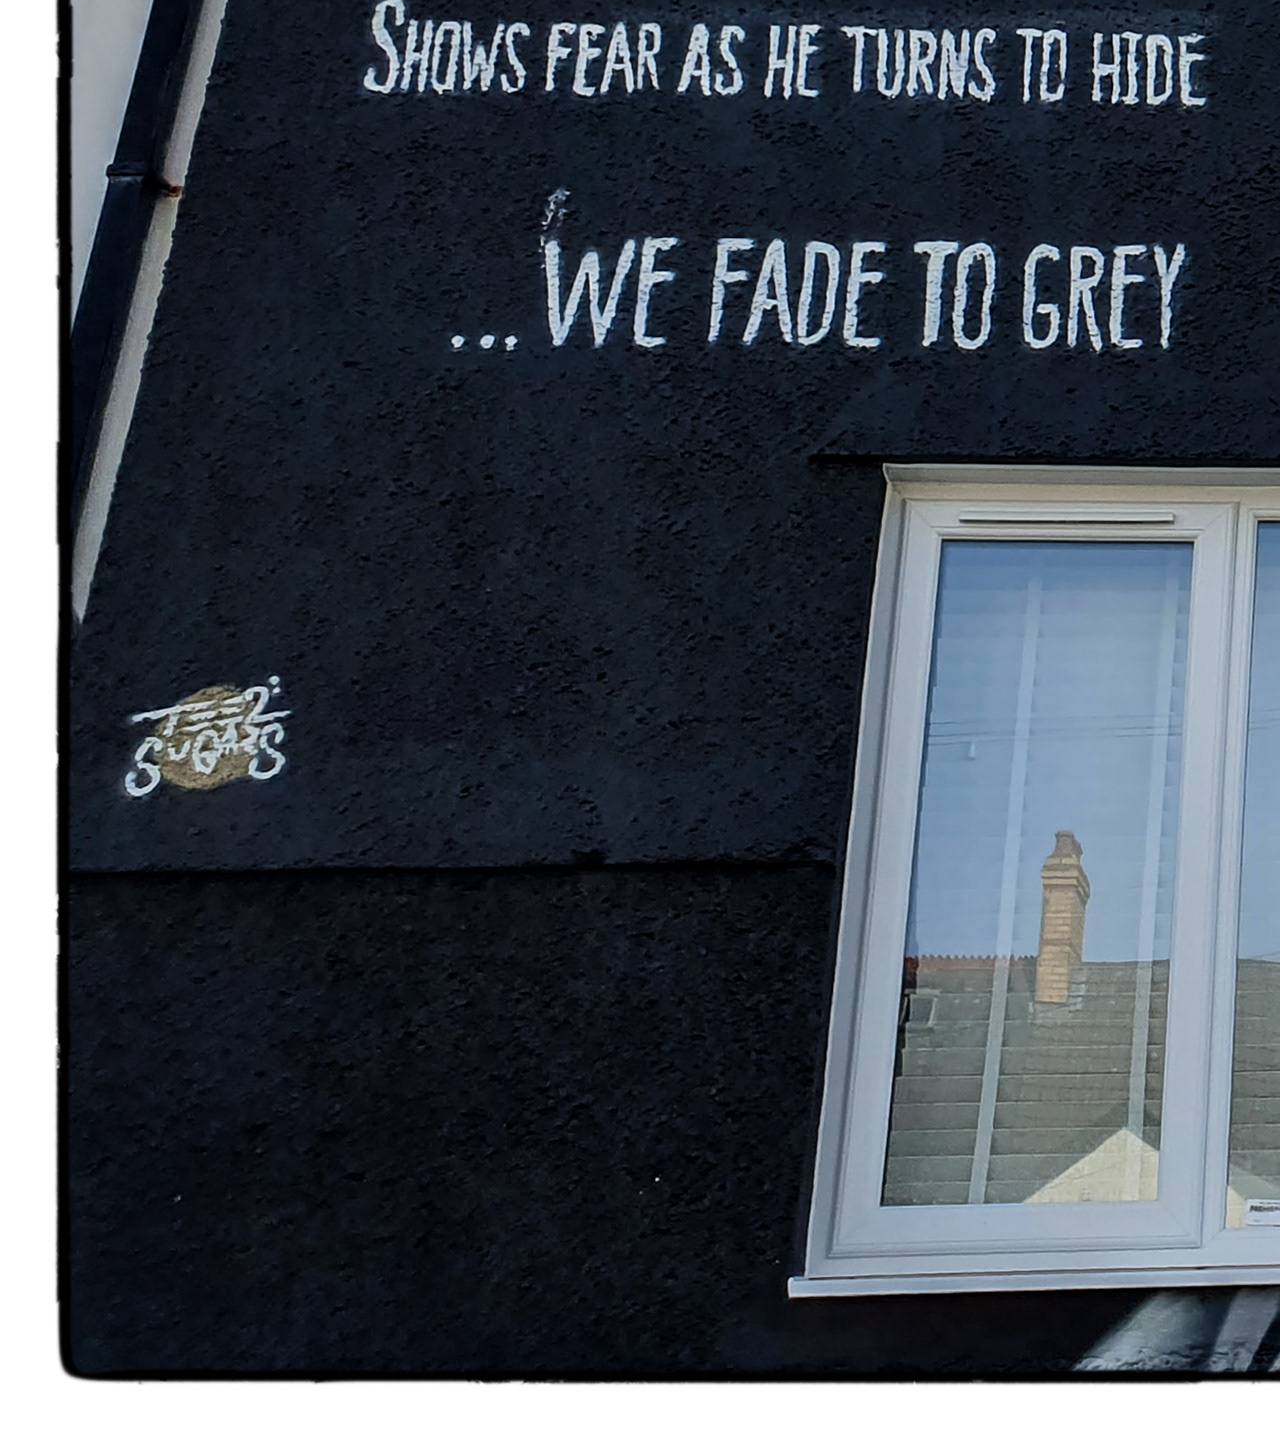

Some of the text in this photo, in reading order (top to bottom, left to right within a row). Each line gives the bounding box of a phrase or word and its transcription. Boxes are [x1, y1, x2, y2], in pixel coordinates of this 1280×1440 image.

[545, 22, 661, 96] FEAR
[677, 24, 745, 96] AS
[764, 24, 822, 99] HE
[841, 26, 996, 102] TURNS
[1016, 29, 1067, 103] TO
[1092, 32, 1206, 106] HIDE
[708, 238, 885, 347] FADE
[914, 241, 995, 349] TO
[1023, 244, 1185, 353] GREY
